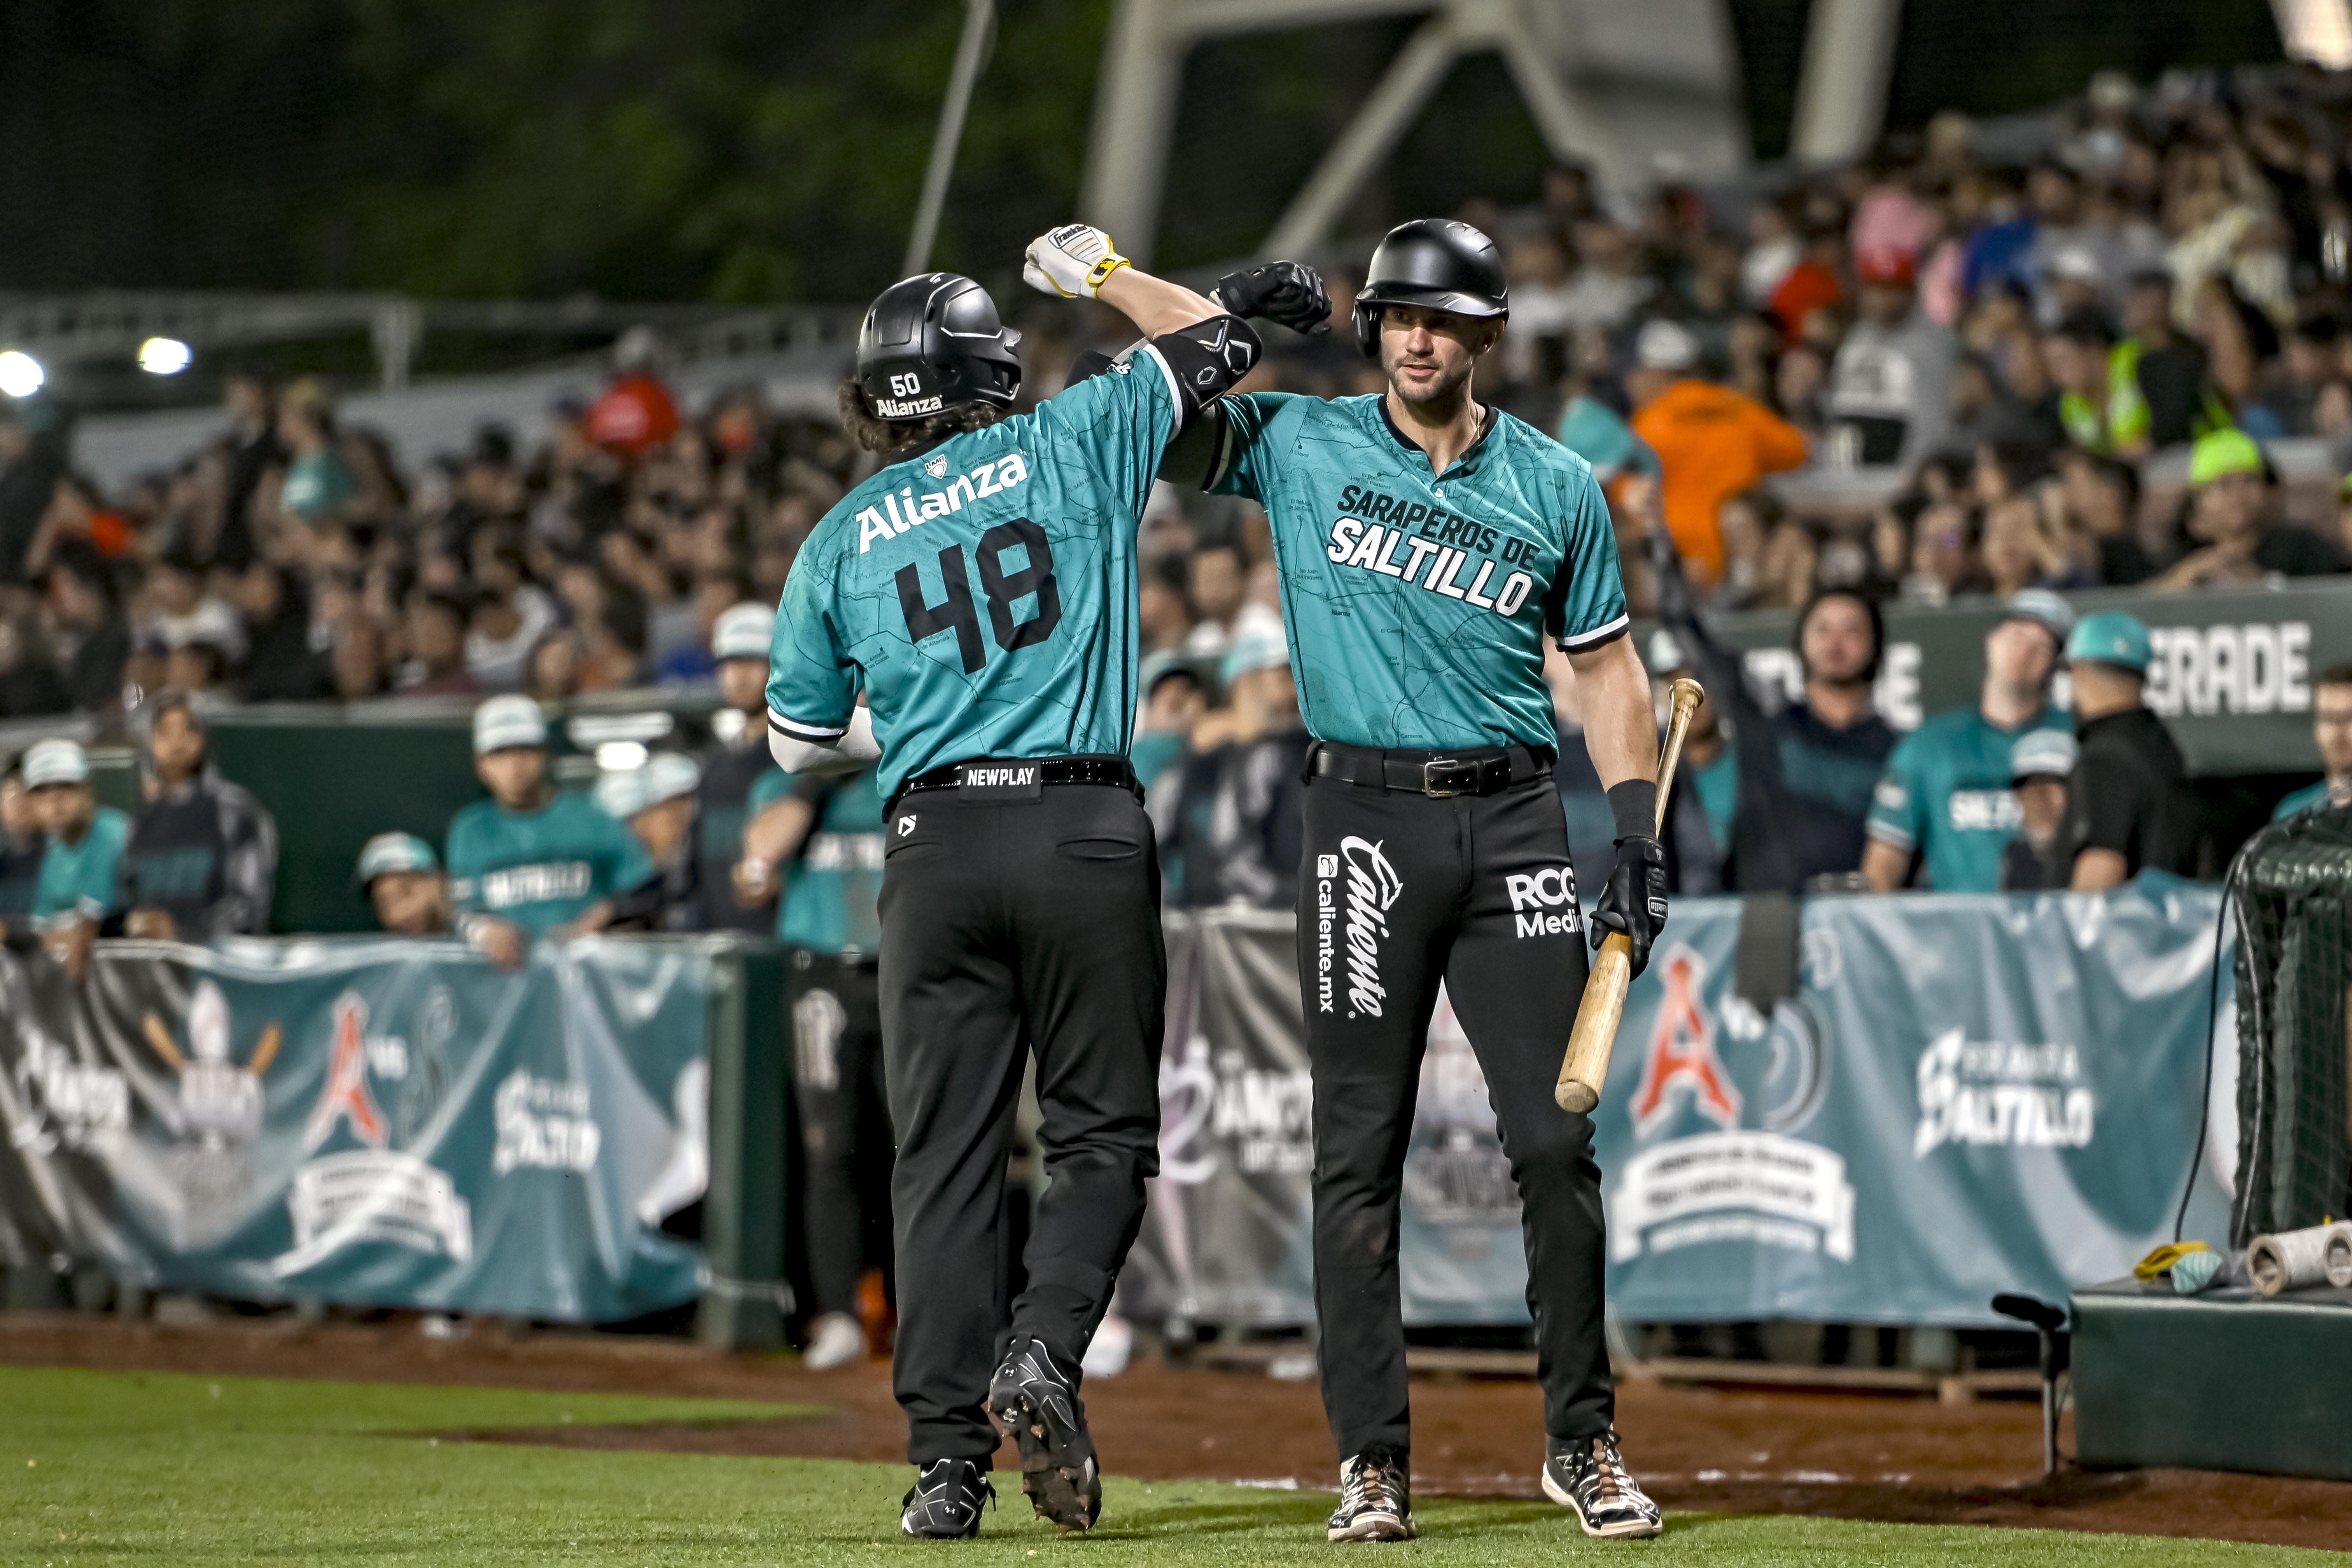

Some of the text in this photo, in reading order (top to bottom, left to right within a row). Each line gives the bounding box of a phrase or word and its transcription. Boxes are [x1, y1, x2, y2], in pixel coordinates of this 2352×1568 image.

[876, 397, 943, 416] Alianza
[890, 372, 920, 397] 50
[855, 453, 1028, 554] Alianza
[926, 456, 944, 469] LMB
[1327, 516, 1533, 618] SALTILLO
[1337, 485, 1540, 571] SARAPEROS DE
[894, 517, 1062, 675] 48
[967, 767, 1034, 786] NEWPLAY
[1341, 836, 1404, 1017] Caliente
[1505, 867, 1577, 911] RCG
[1319, 879, 1336, 1013] caliente.mx
